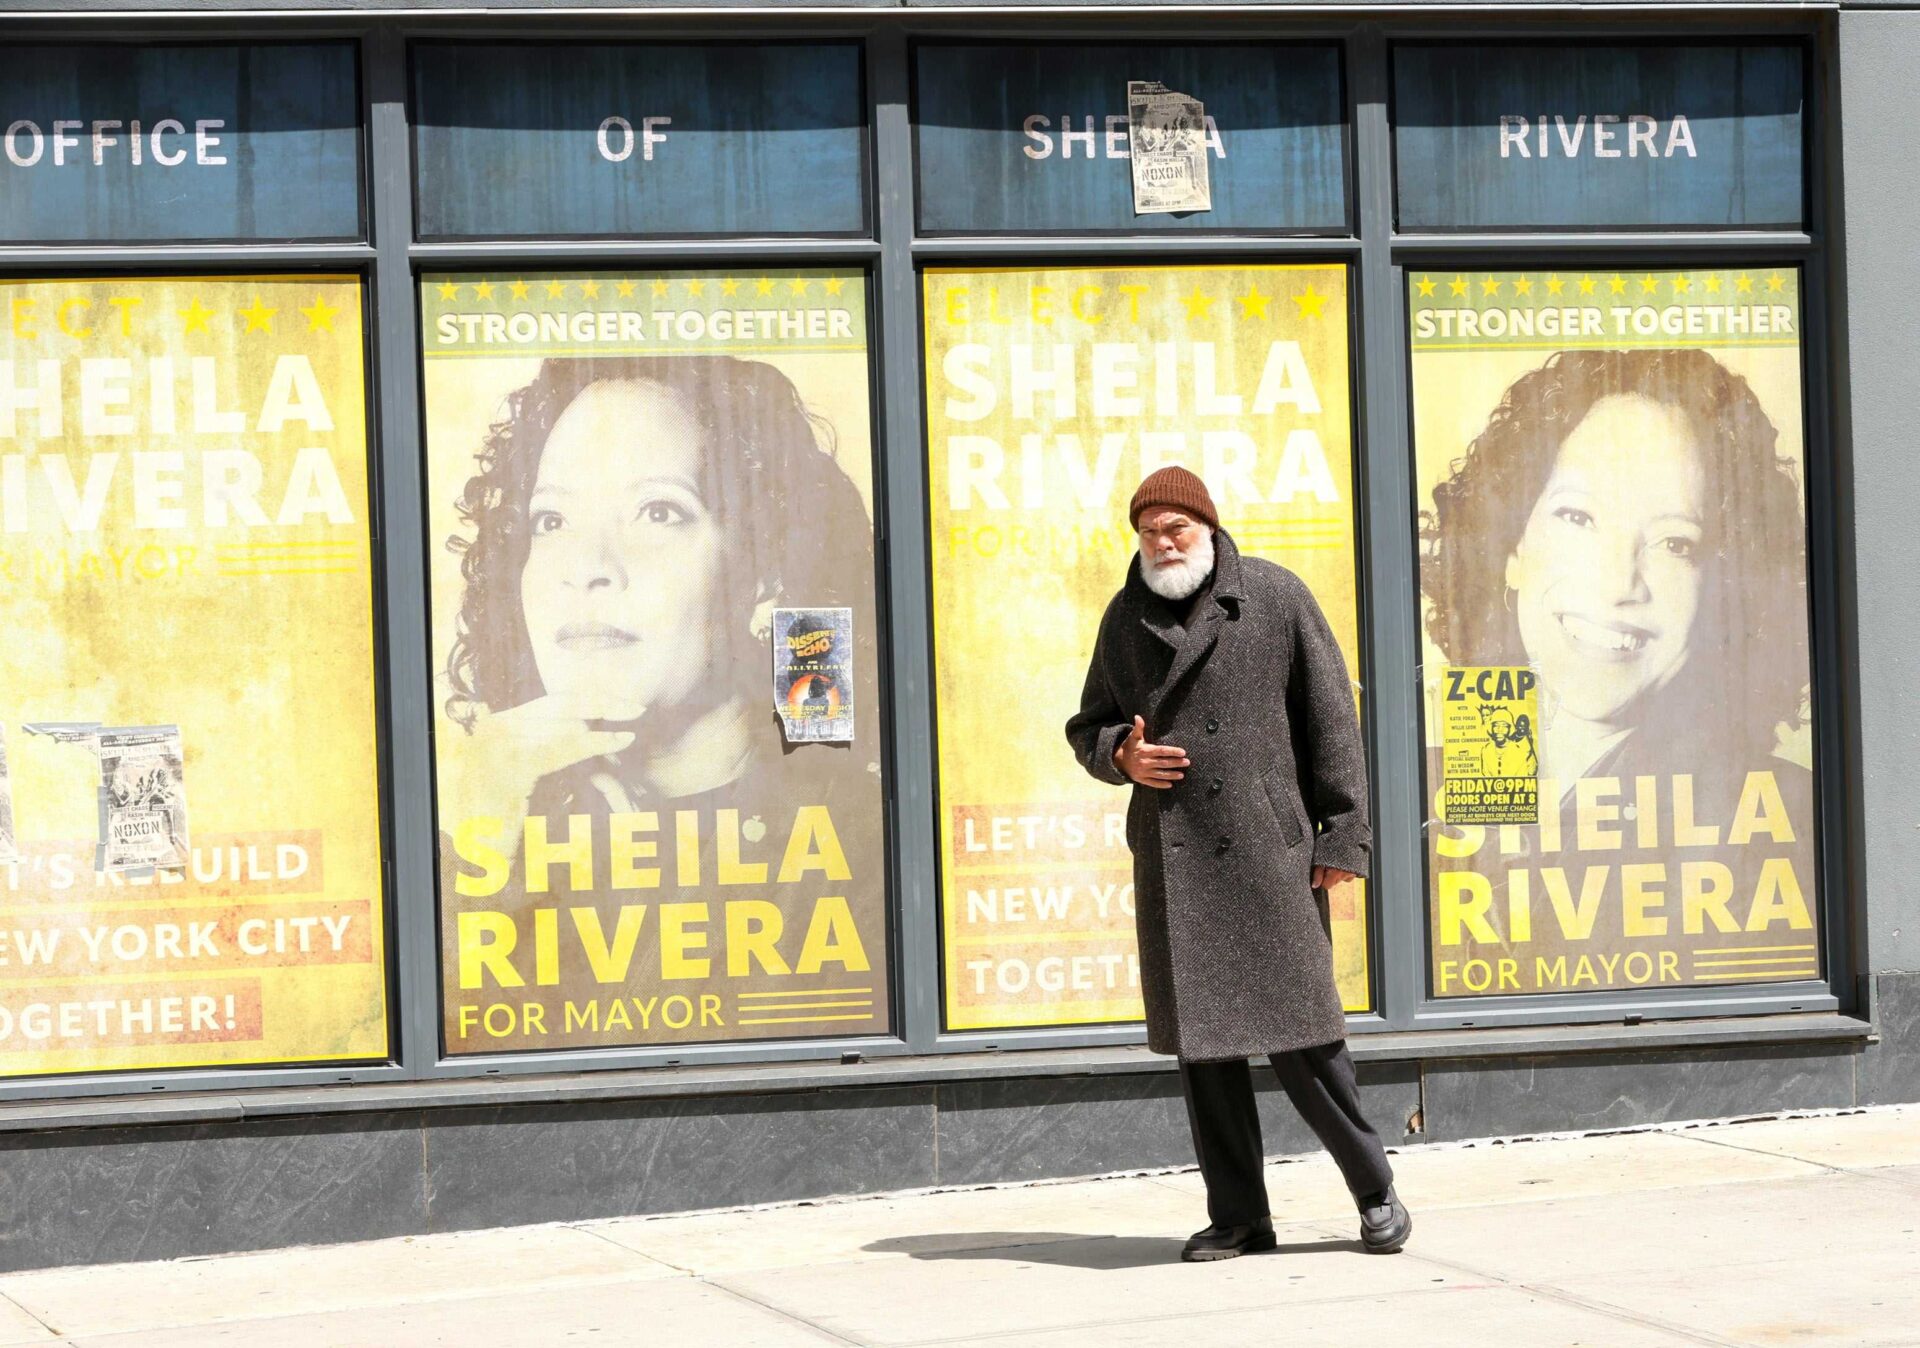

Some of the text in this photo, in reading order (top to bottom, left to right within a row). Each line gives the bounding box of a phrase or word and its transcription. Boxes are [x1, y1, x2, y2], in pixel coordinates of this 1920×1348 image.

[4, 114, 1698, 167] OFFICE OF SHEA RIVERA
[1142, 166, 1184, 181] NOXON
[945, 284, 1150, 326] ELECT
[1414, 304, 1794, 339] STRONGER TOGETHER
[436, 309, 853, 344] STRONGER TOGETHER
[942, 340, 1323, 423] SHEILA
[949, 524, 1037, 559] FOR
[796, 637, 831, 657] ECHO
[1446, 670, 1536, 701] Z-CAP
[1446, 779, 1536, 793] FRIDAY@9PM
[1446, 793, 1536, 805] DOORS OPEN AT 8
[114, 821, 160, 838] NOXON
[963, 814, 1086, 852] LET'S
[95, 844, 309, 886] UILD
[453, 806, 852, 897] SHEILA
[966, 885, 1075, 923] NEW
[1437, 858, 1812, 945] RIVERA
[79, 921, 229, 962] YORK
[237, 915, 352, 956] CITY
[458, 896, 870, 989] RIVERA
[1440, 951, 1682, 992] FOR MAYOR
[459, 994, 725, 1038] FOR MAYOR
